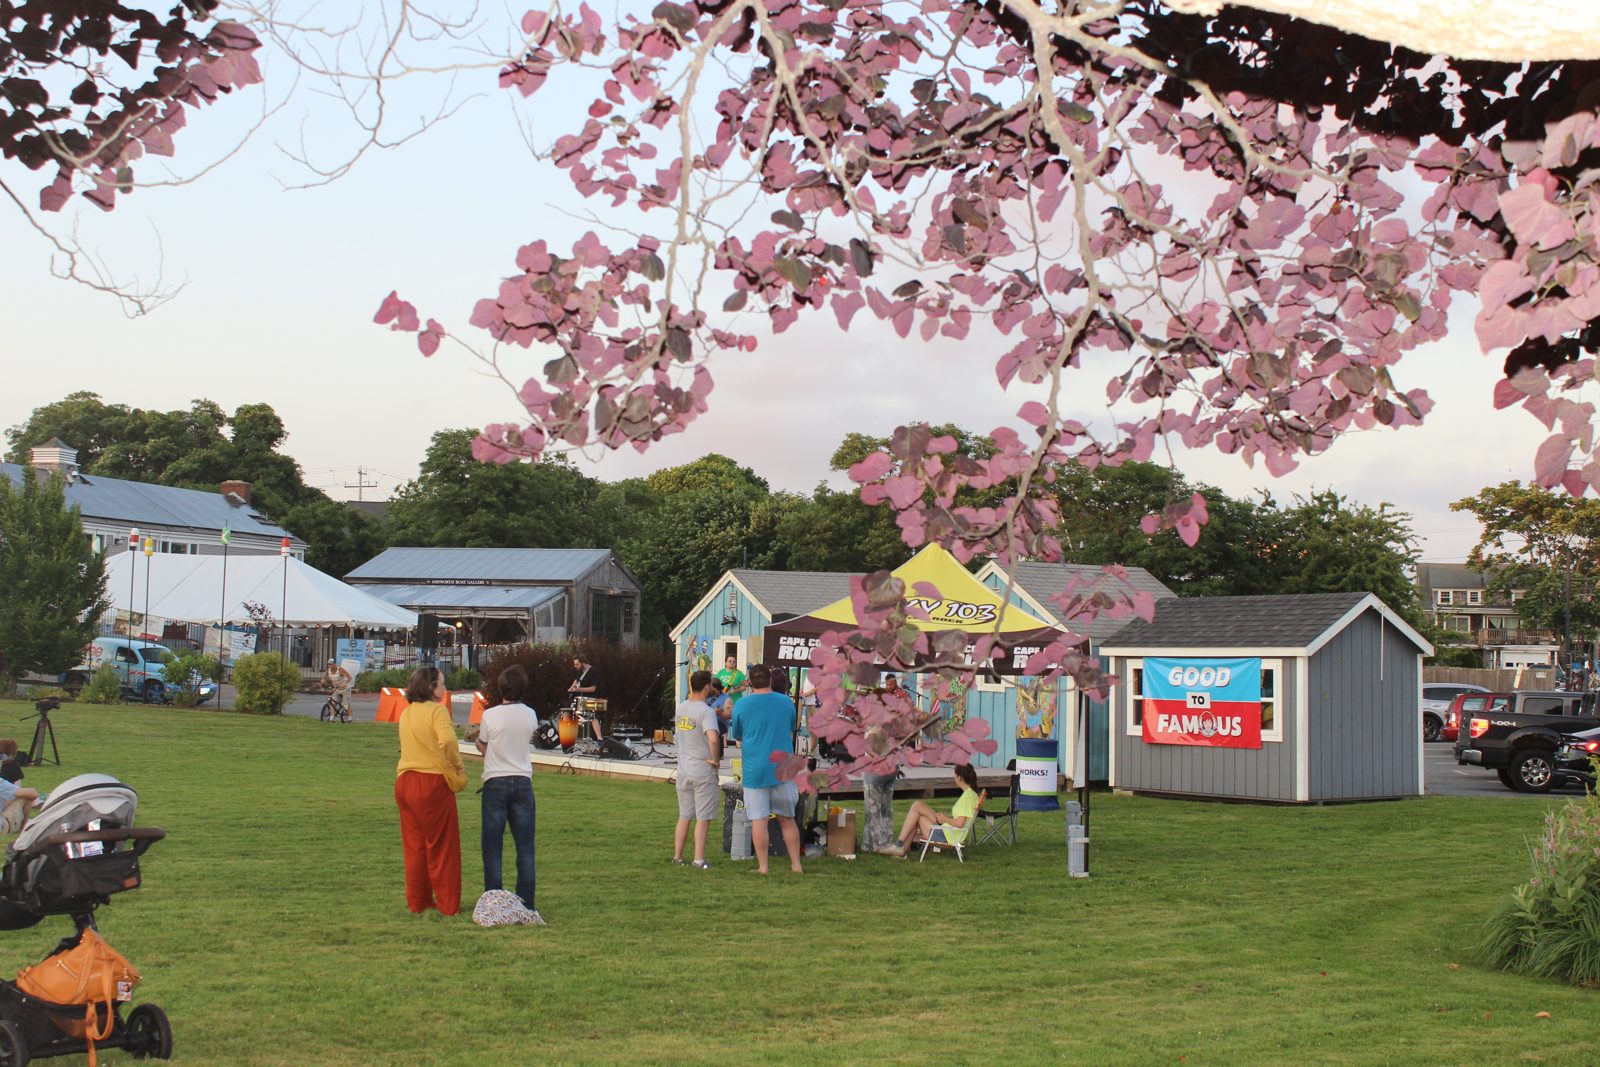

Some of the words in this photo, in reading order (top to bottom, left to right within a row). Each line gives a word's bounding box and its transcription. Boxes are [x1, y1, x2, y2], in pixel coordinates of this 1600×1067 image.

[945, 602, 997, 621] 103
[780, 636, 806, 646] CAPE
[808, 638, 821, 647] CO
[1168, 666, 1231, 687] GOOD
[1191, 695, 1205, 705] TO
[1020, 768, 1049, 777] WORKS!
